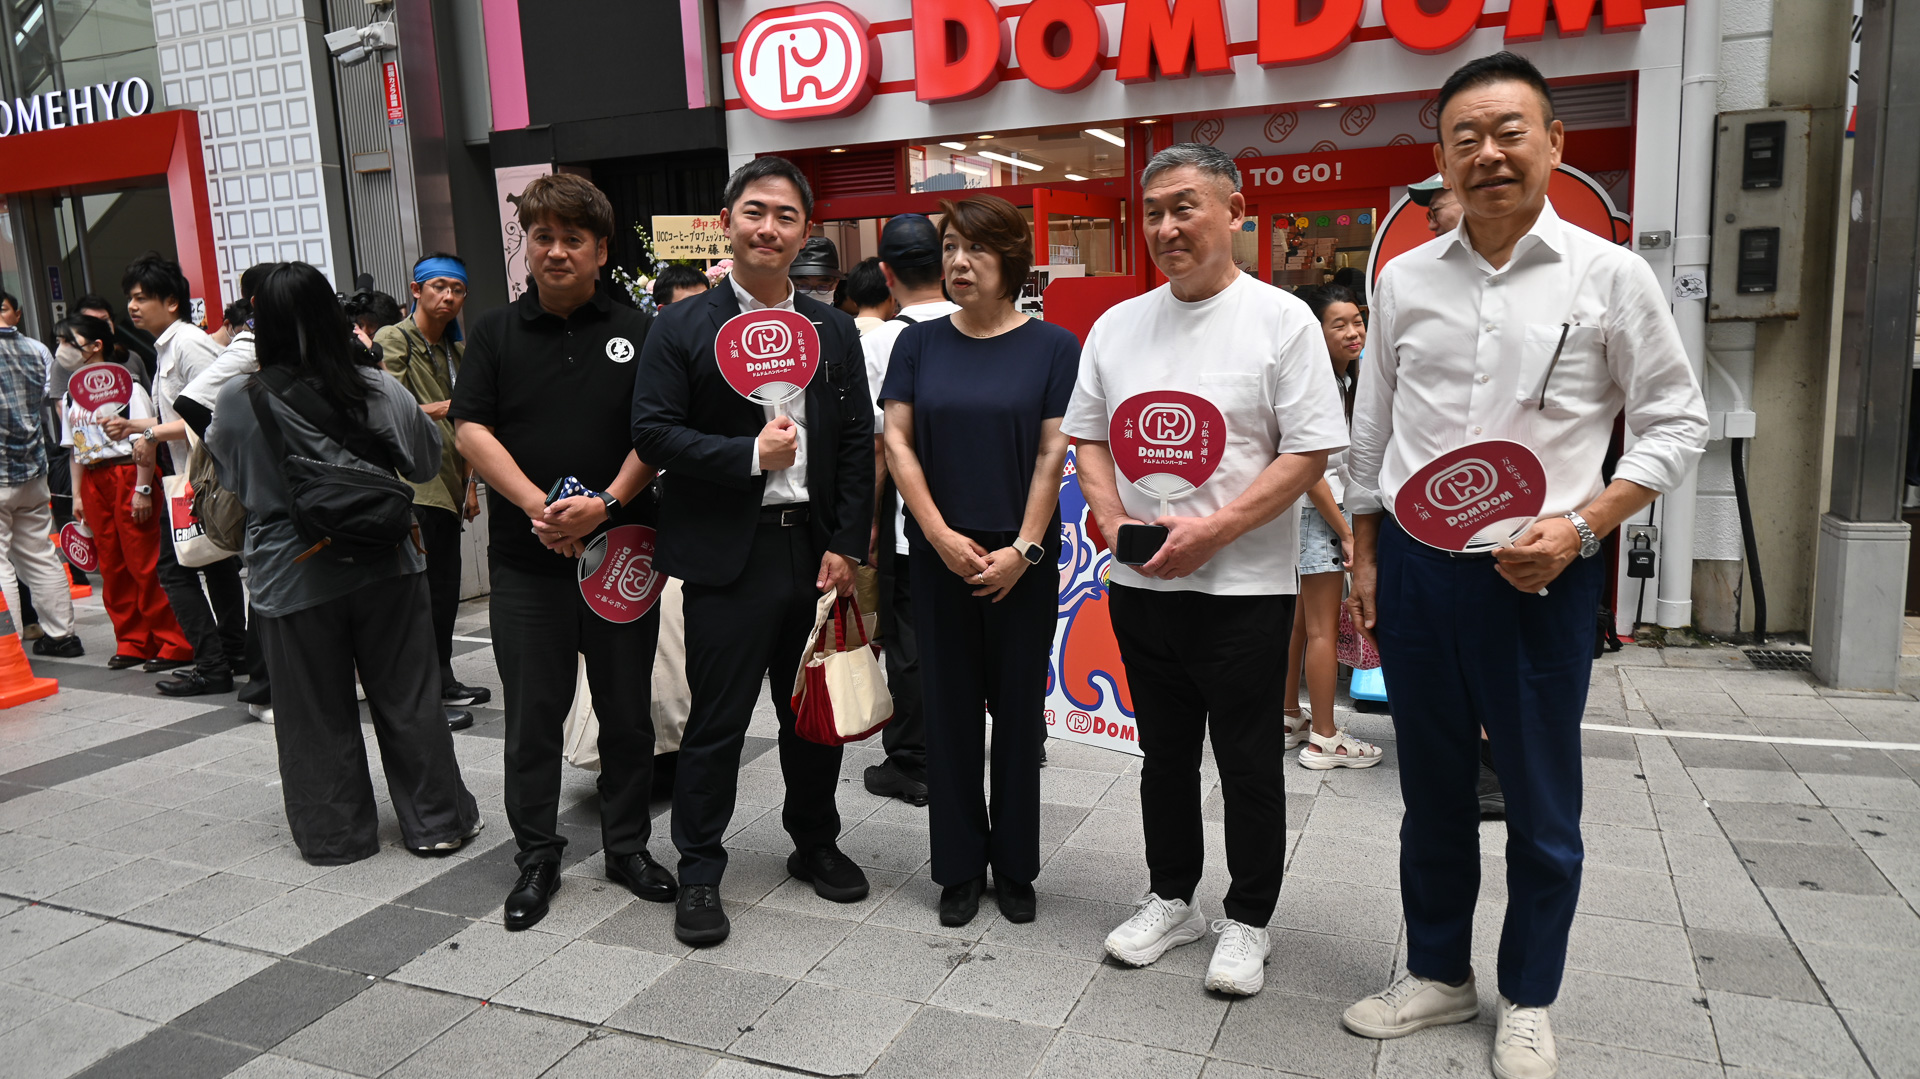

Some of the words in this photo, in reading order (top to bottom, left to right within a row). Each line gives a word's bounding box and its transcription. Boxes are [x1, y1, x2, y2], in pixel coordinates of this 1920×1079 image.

[1250, 167, 1284, 187] TO
[1292, 162, 1342, 184] GO!
[729, 339, 739, 358] 大須
[746, 358, 795, 373] DOMDOM
[752, 368, 792, 377] ドムドムハンバーガー
[1124, 418, 1133, 439] 大須
[1138, 446, 1194, 460] DOMDOM
[1200, 421, 1209, 464] 万松寺通り
[1412, 502, 1432, 521] 大須
[1445, 490, 1514, 527] DOMDOM
[1458, 503, 1511, 529] ドムドムハンバーガー
[603, 546, 632, 590] DOMDOM
[1093, 716, 1141, 742] DOM
